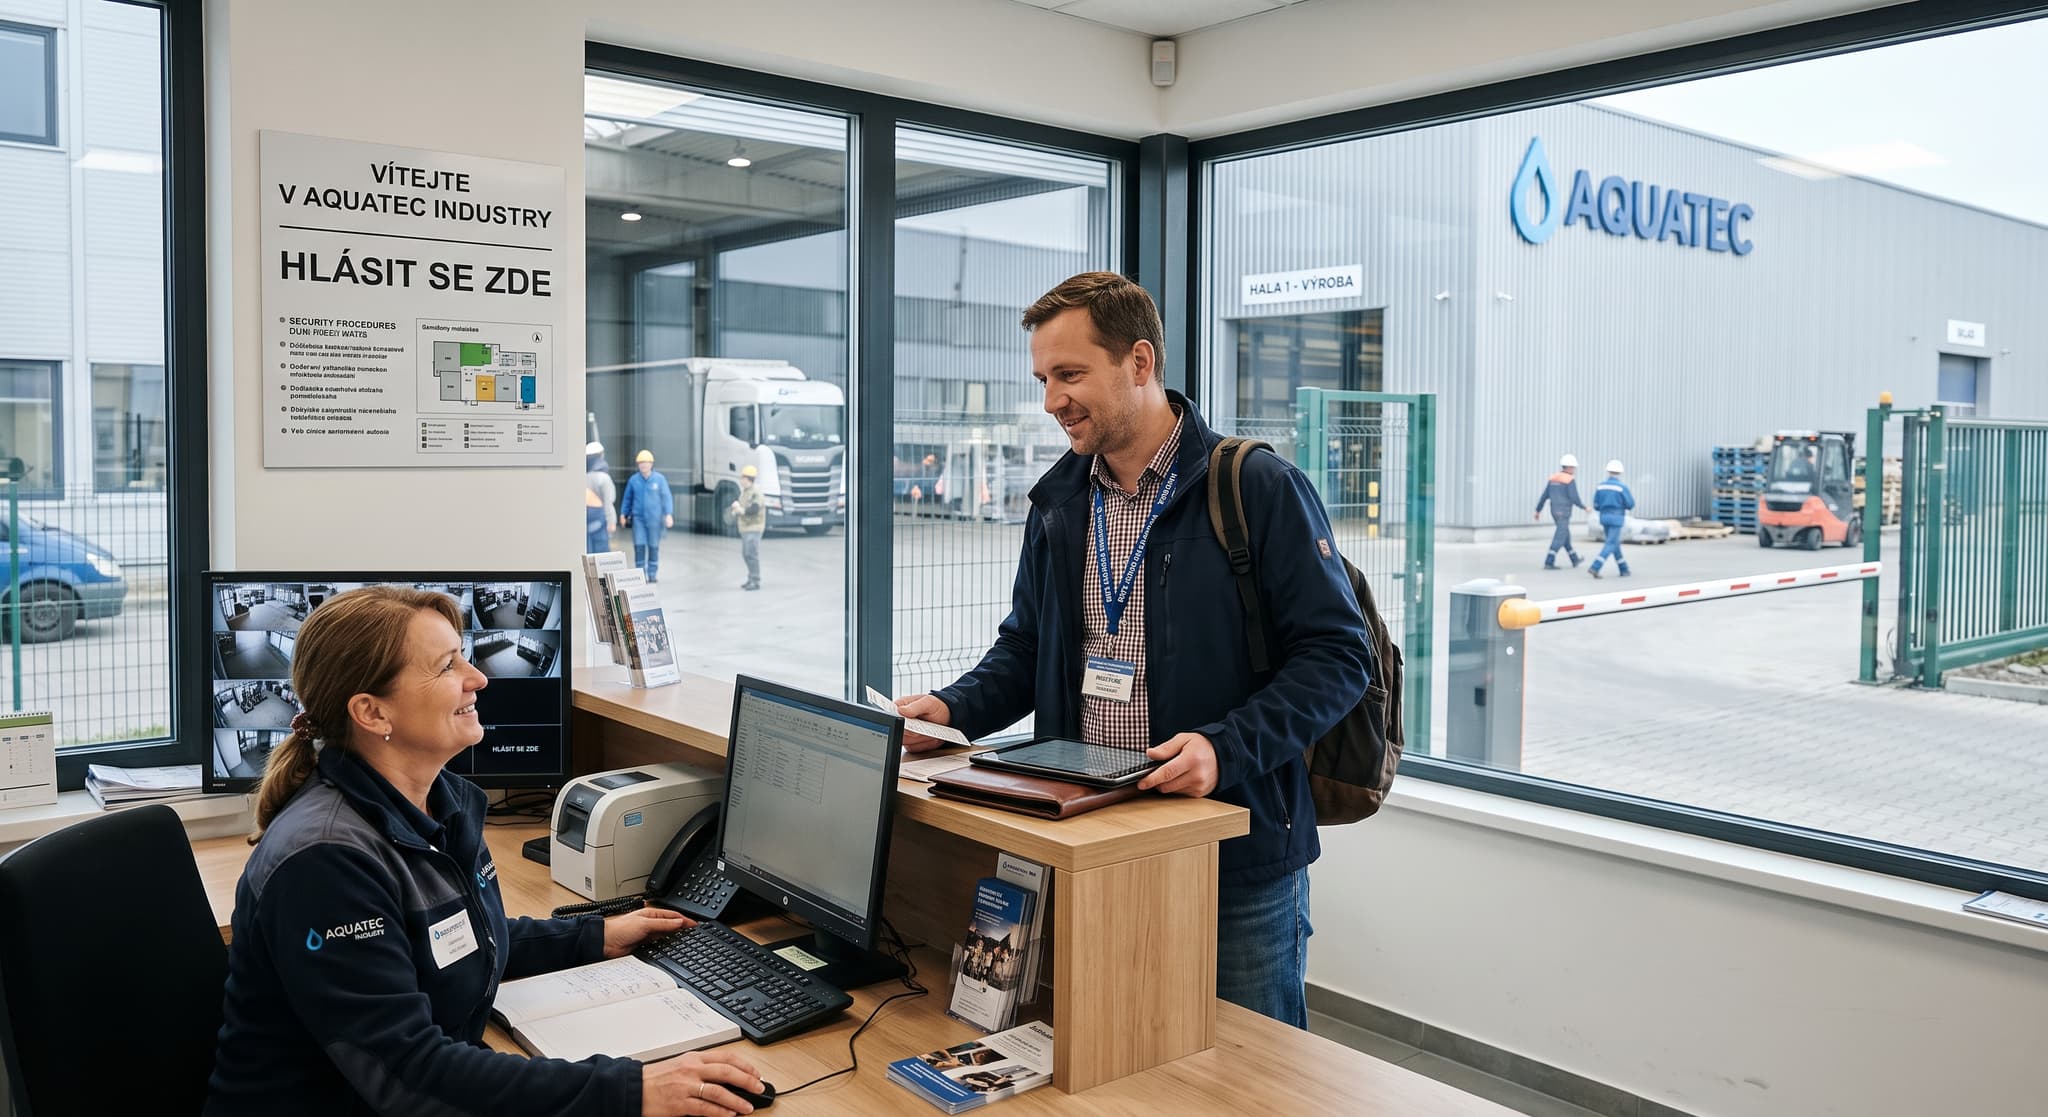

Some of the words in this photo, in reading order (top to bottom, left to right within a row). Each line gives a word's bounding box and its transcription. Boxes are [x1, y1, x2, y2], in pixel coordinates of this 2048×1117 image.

[371, 161, 470, 192] VÍTEJTE
[279, 184, 296, 204] V
[303, 187, 426, 216] AQUATEC
[435, 200, 552, 228] INDUSTRY
[1564, 169, 1754, 256] AQUATEC
[281, 248, 417, 287] HLÁSIT
[429, 262, 474, 292] SE
[485, 266, 551, 297] ZDE
[1250, 282, 1282, 295] HALA
[1285, 281, 1290, 292] 1
[1301, 275, 1354, 291] VÝROBA
[289, 317, 334, 327] SECURITY
[326, 917, 384, 940] AQUATEC
